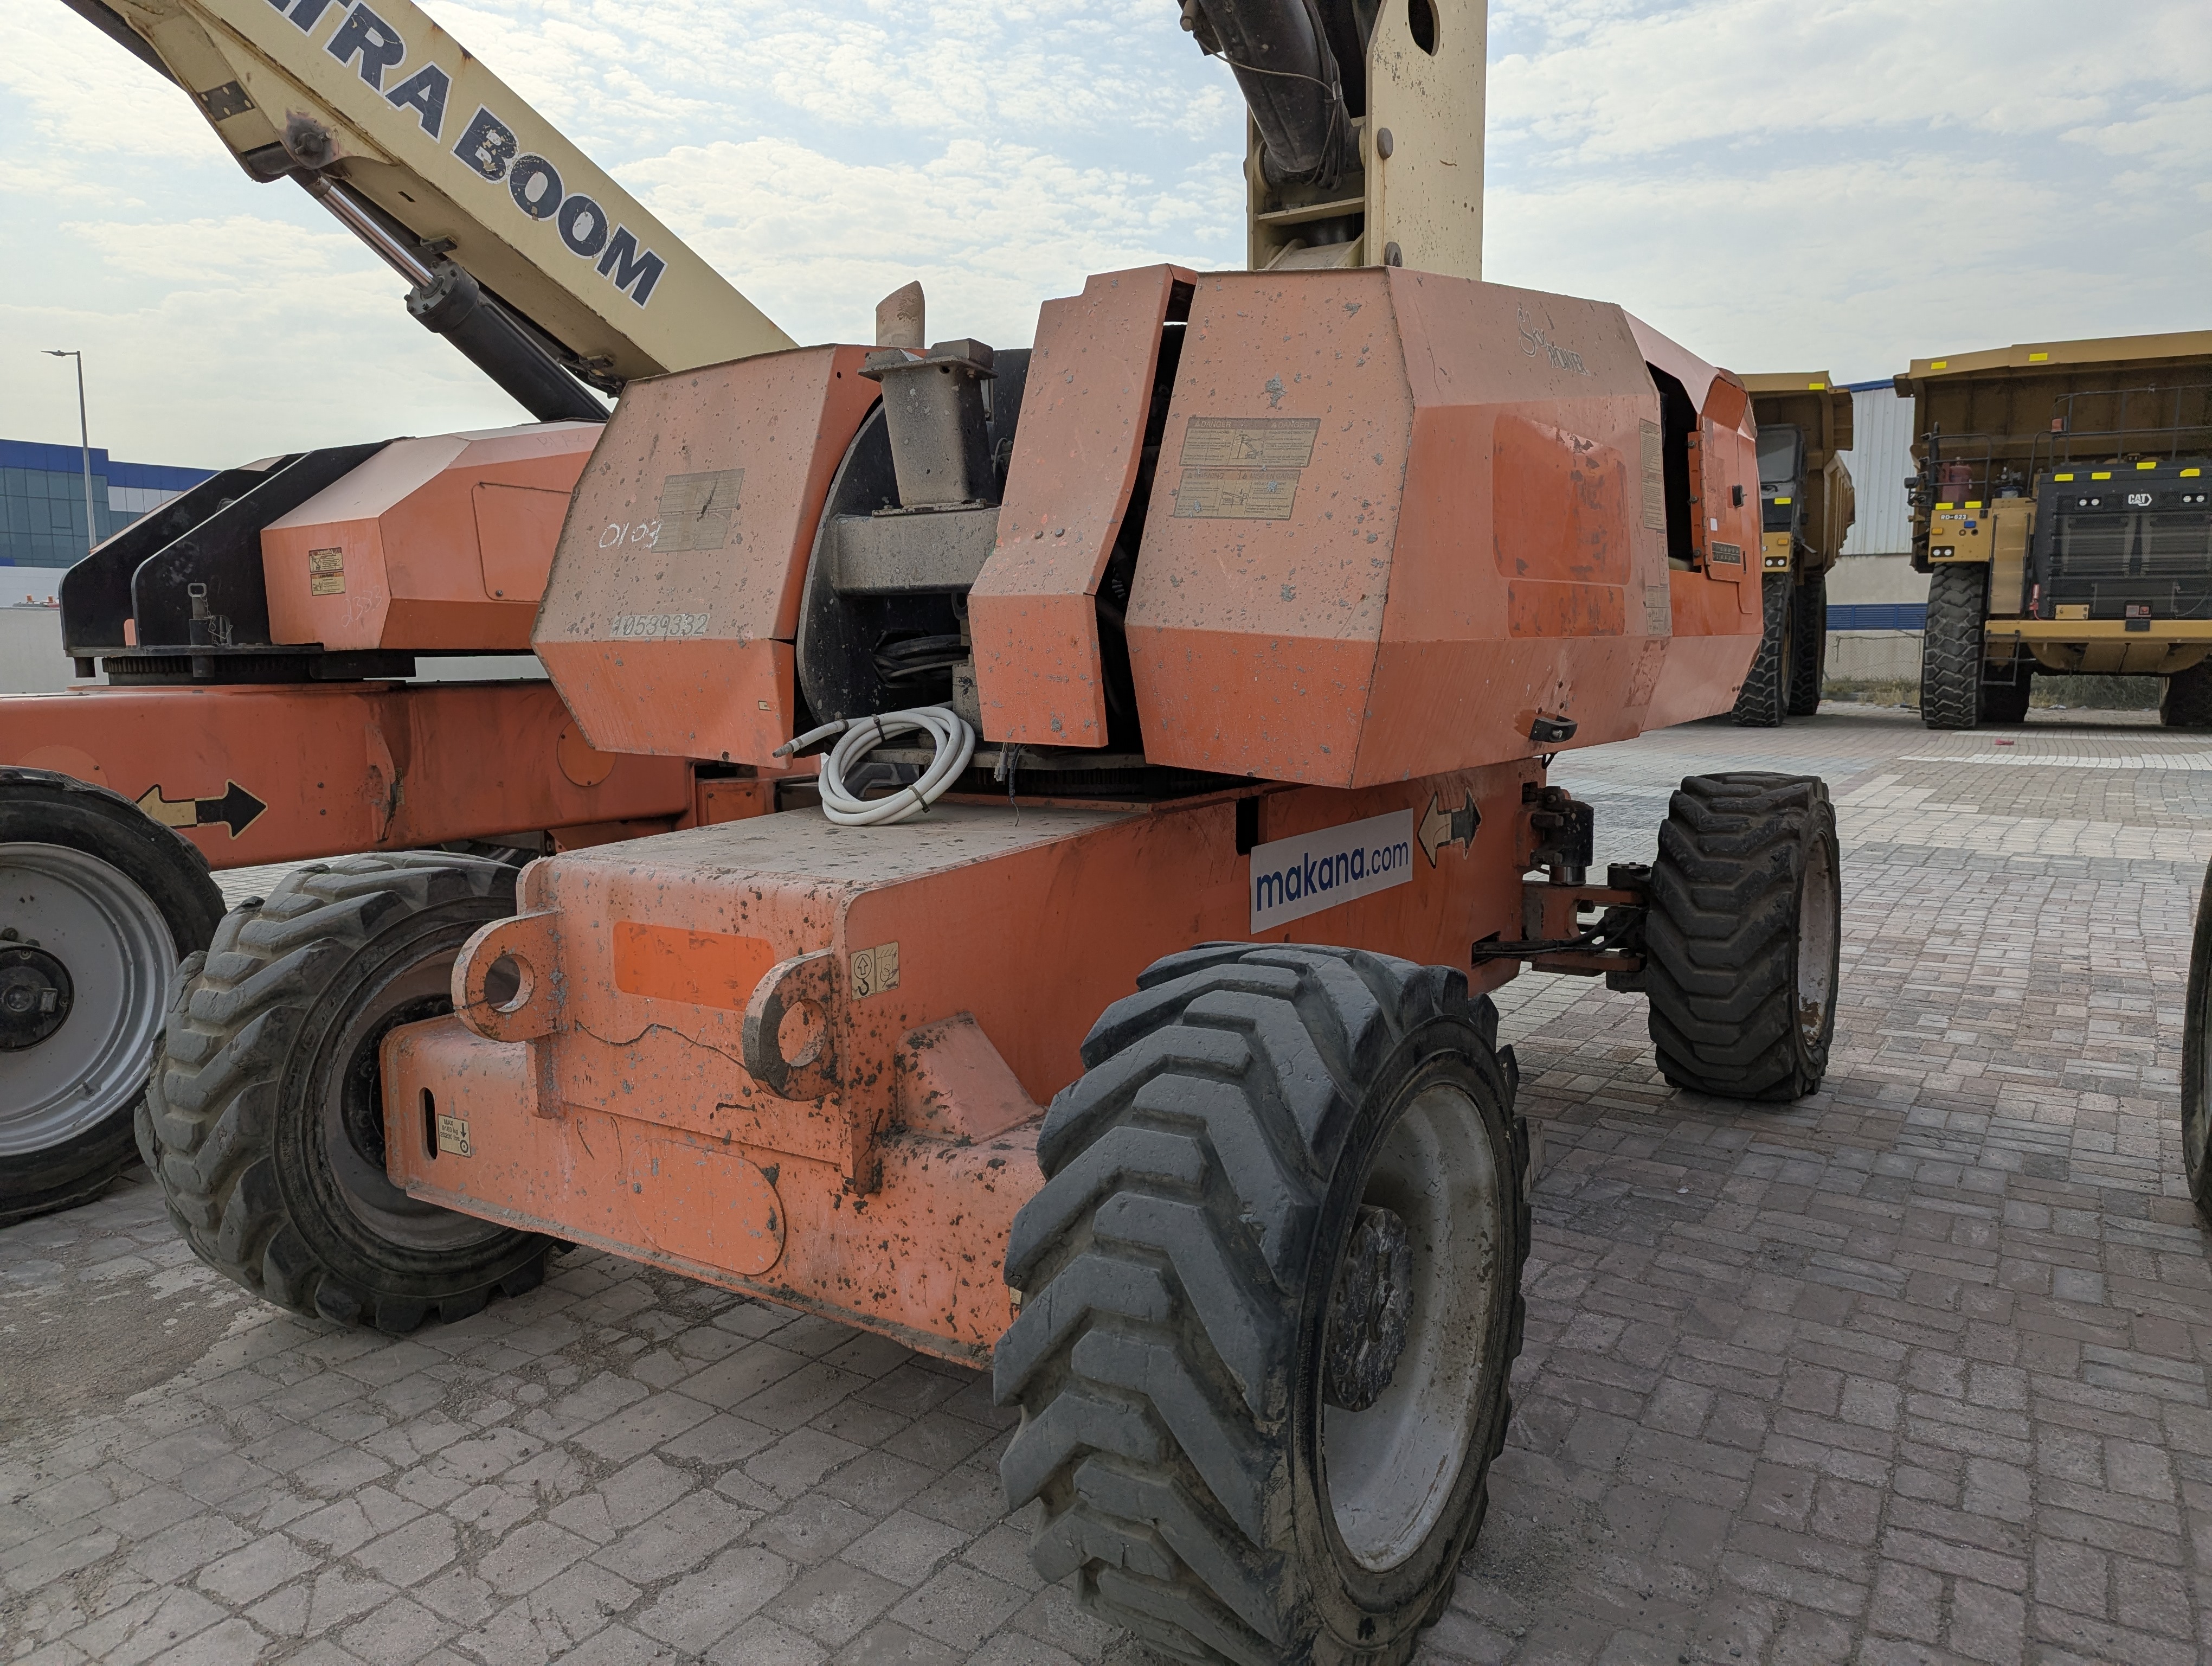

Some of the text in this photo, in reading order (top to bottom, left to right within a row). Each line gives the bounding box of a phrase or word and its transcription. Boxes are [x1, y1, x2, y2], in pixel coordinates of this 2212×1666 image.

[451, 104, 667, 309] BOOM
[2128, 494, 2147, 504] CAT
[1257, 841, 1409, 912] makana.com
